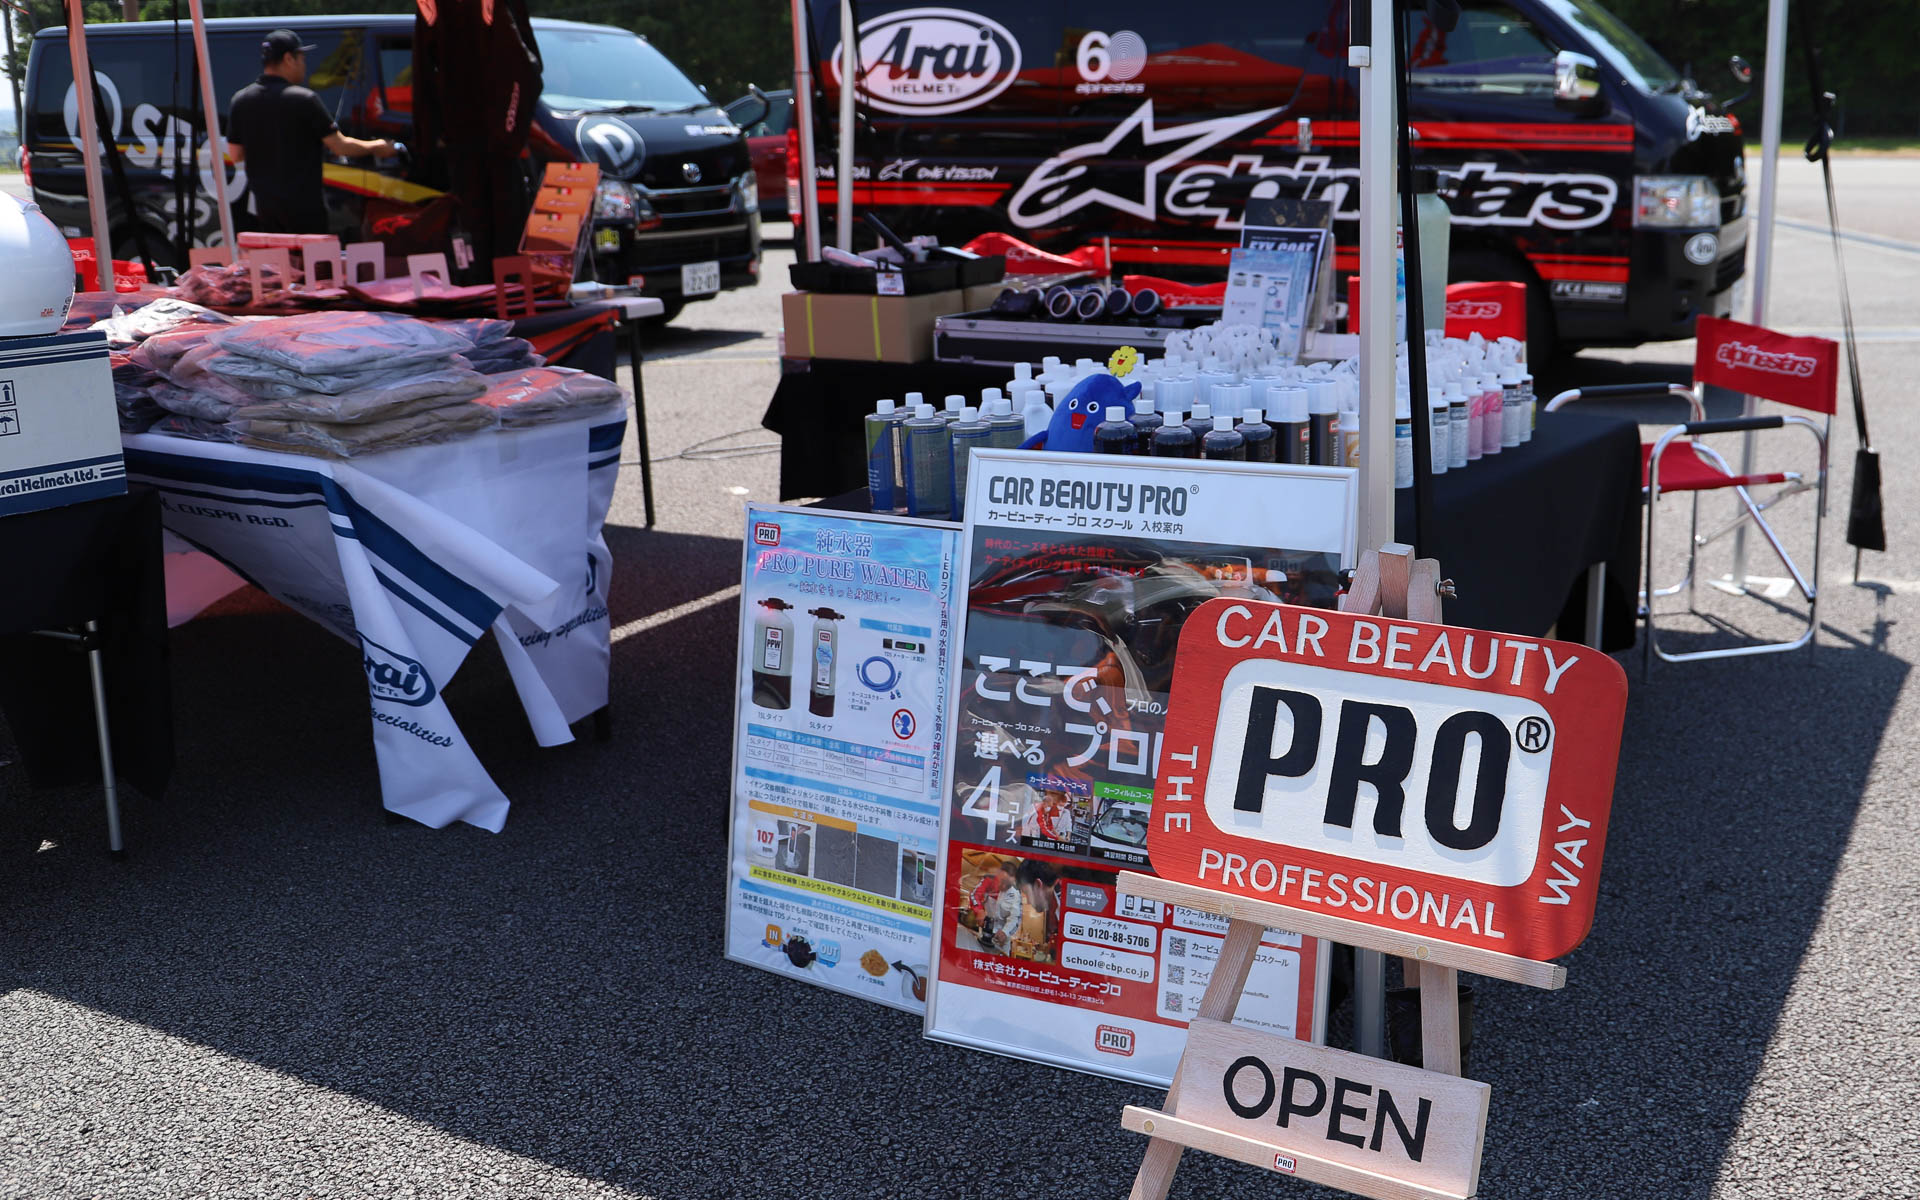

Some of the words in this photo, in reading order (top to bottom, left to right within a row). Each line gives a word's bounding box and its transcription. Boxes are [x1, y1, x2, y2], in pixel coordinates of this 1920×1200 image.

[865, 26, 992, 80] Arai
[0, 479, 20, 496] rai
[989, 476, 1034, 505] CAR
[1040, 478, 1133, 513] BEAUTY
[759, 528, 775, 540] PRO
[988, 509, 1062, 525] カービューティー
[1067, 513, 1087, 527] プロ
[1091, 516, 1133, 530] スクール
[1141, 520, 1184, 534] 入校案内
[816, 529, 873, 558] 純水器
[761, 551, 797, 574] PRO
[802, 556, 854, 581] PURE
[860, 562, 930, 591] WATER
[1217, 605, 1328, 657] CAR
[1347, 620, 1580, 694] BEAUTY
[974, 731, 1046, 766] 選べる
[1064, 721, 1164, 779] プロ
[1029, 776, 1088, 791] カービューティーコース
[1103, 786, 1153, 800] カーフィルムコース
[1164, 745, 1199, 833] THE
[962, 766, 1010, 840] 4
[757, 829, 774, 844] 107
[1005, 801, 1021, 844] コース
[1538, 804, 1592, 906] WAY
[1198, 848, 1506, 940] PROFESSIONAL
[769, 929, 778, 941] IN
[821, 944, 839, 957] OUT
[1088, 928, 1150, 948] 0120-88-5706
[973, 958, 1016, 977] 株式会社
[1017, 968, 1122, 997] カービューティープロ
[1065, 956, 1150, 979] school@cbp.co.jp
[1103, 1033, 1127, 1048] PRO
[1223, 1056, 1432, 1162] OPEN
[1278, 1158, 1293, 1169] PRO
